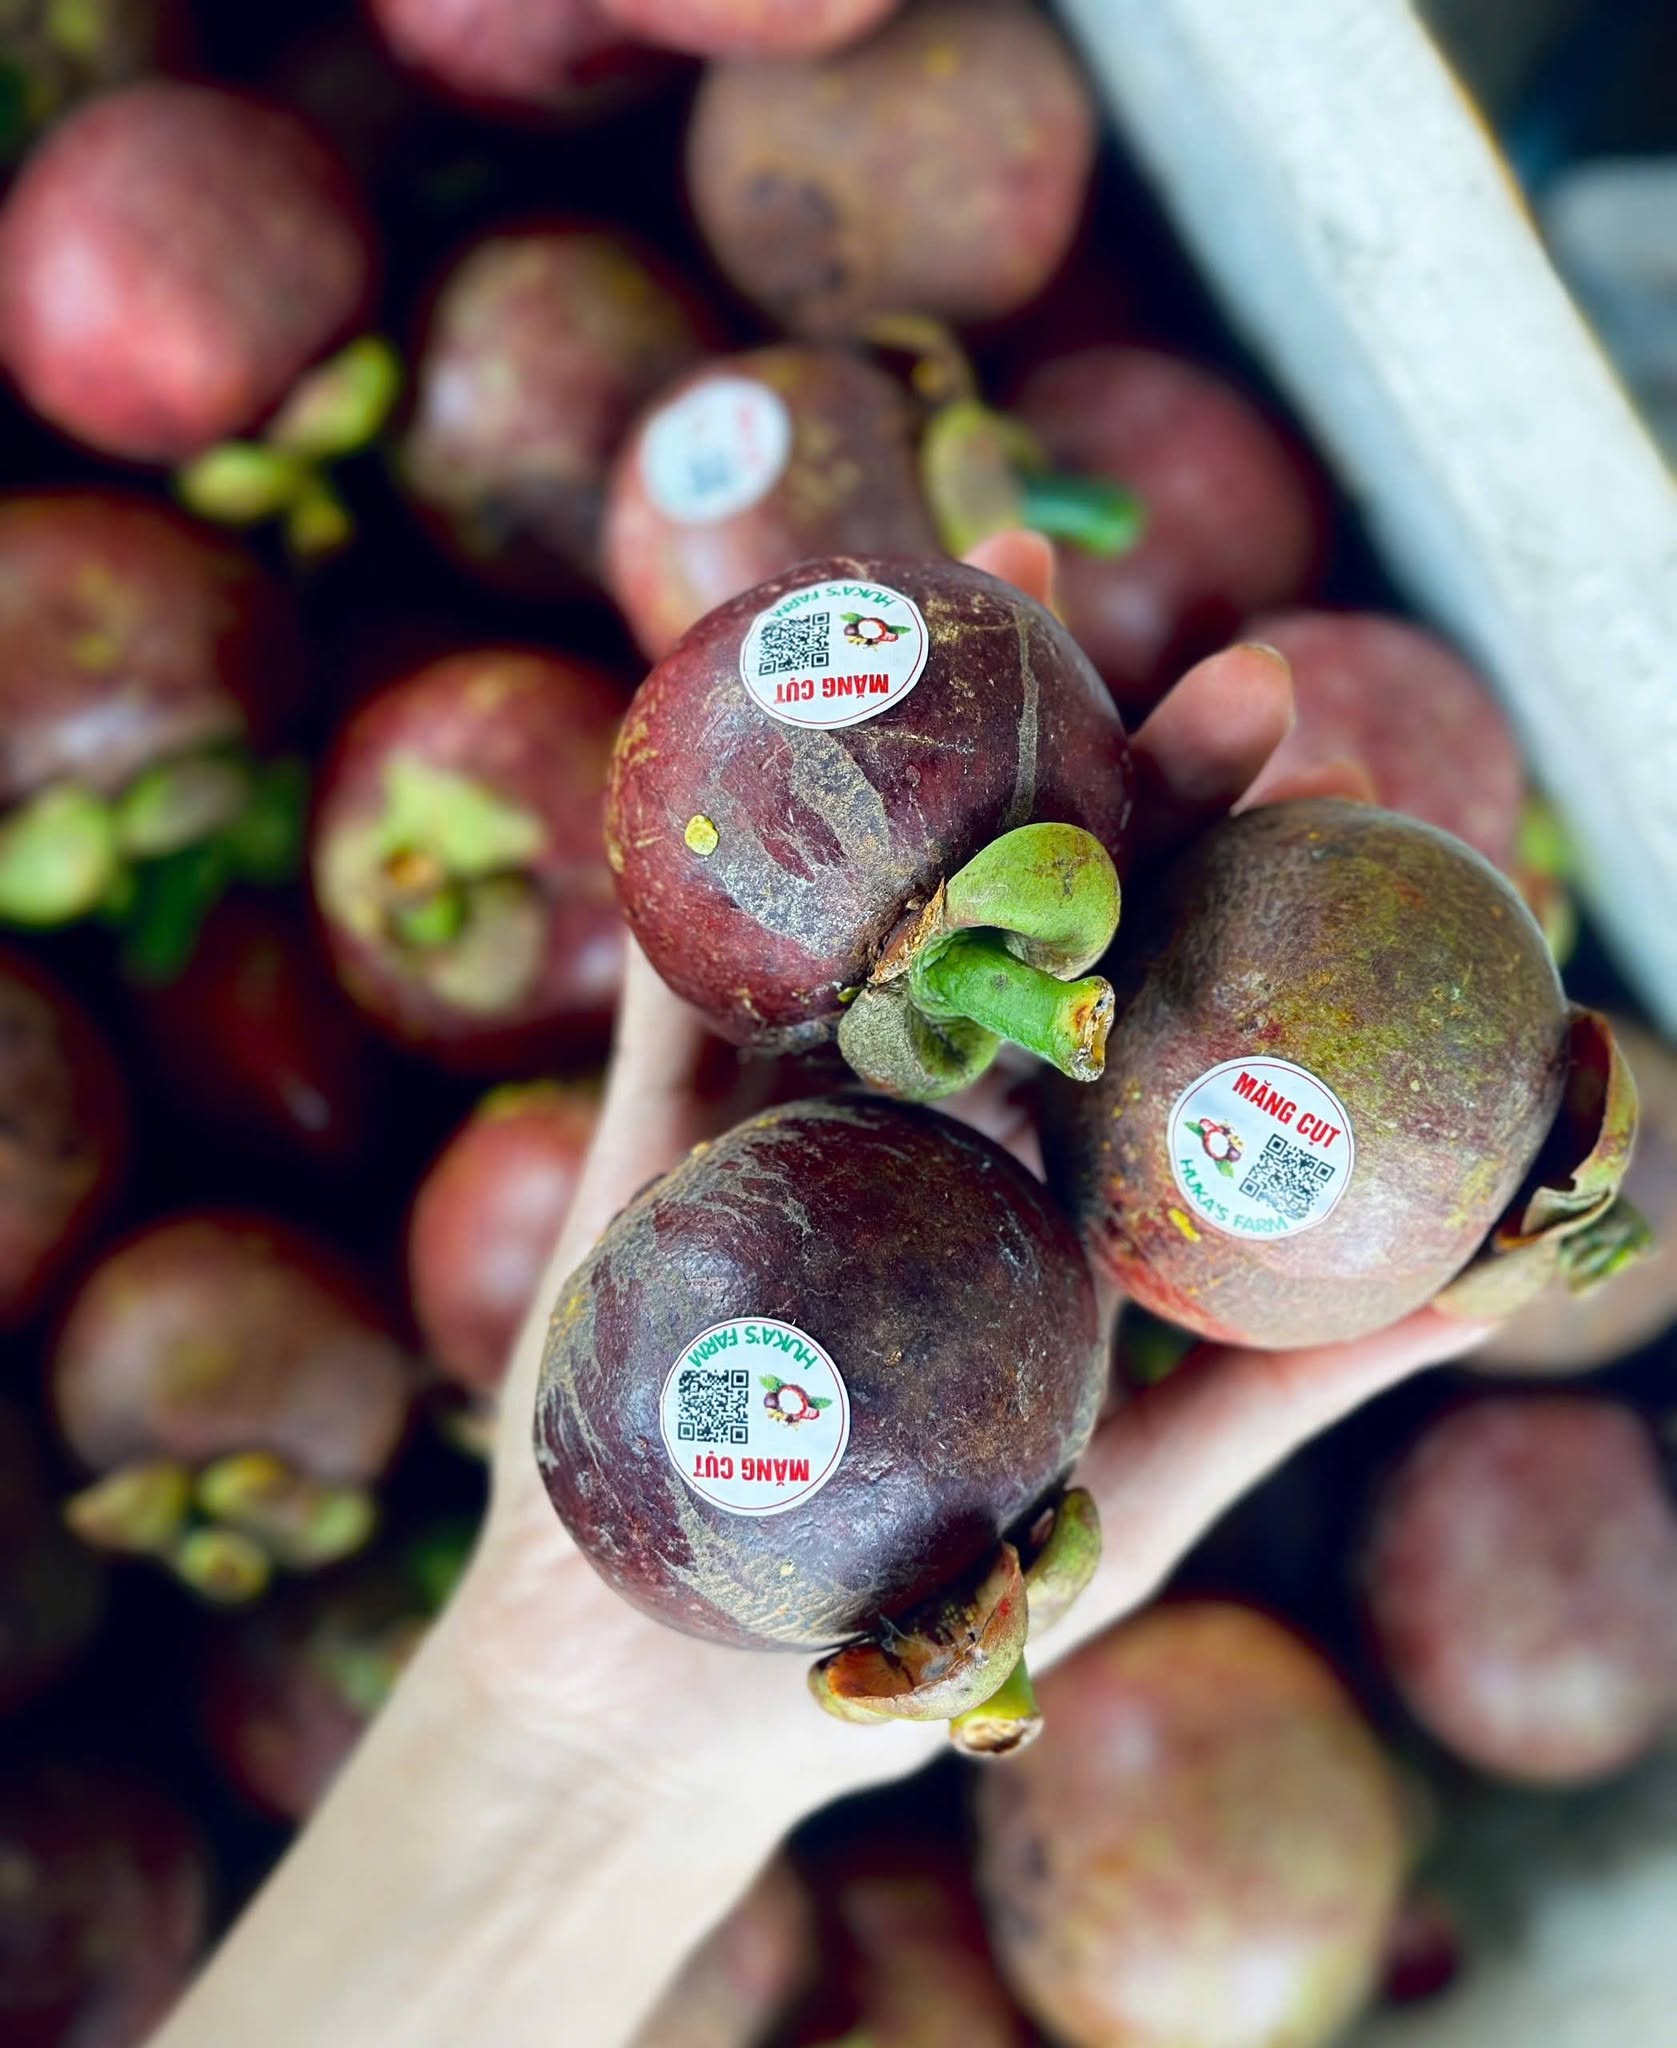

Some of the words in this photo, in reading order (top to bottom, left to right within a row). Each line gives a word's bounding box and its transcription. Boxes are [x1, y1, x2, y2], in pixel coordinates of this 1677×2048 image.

[770, 590, 820, 618] FARM
[827, 585, 896, 608] HUKA'S
[774, 677, 815, 704] CỤT
[822, 673, 889, 699] MĂNG
[1232, 1071, 1297, 1125] MĂNG
[1296, 1112, 1341, 1148] CỤT
[1180, 1159, 1229, 1222] HUKA'S
[1233, 1214, 1288, 1233] FARM
[687, 1327, 738, 1368] FARM
[744, 1325, 818, 1370] HUKA'S
[693, 1450, 734, 1479] CỤT
[741, 1458, 810, 1487] MĂNG
